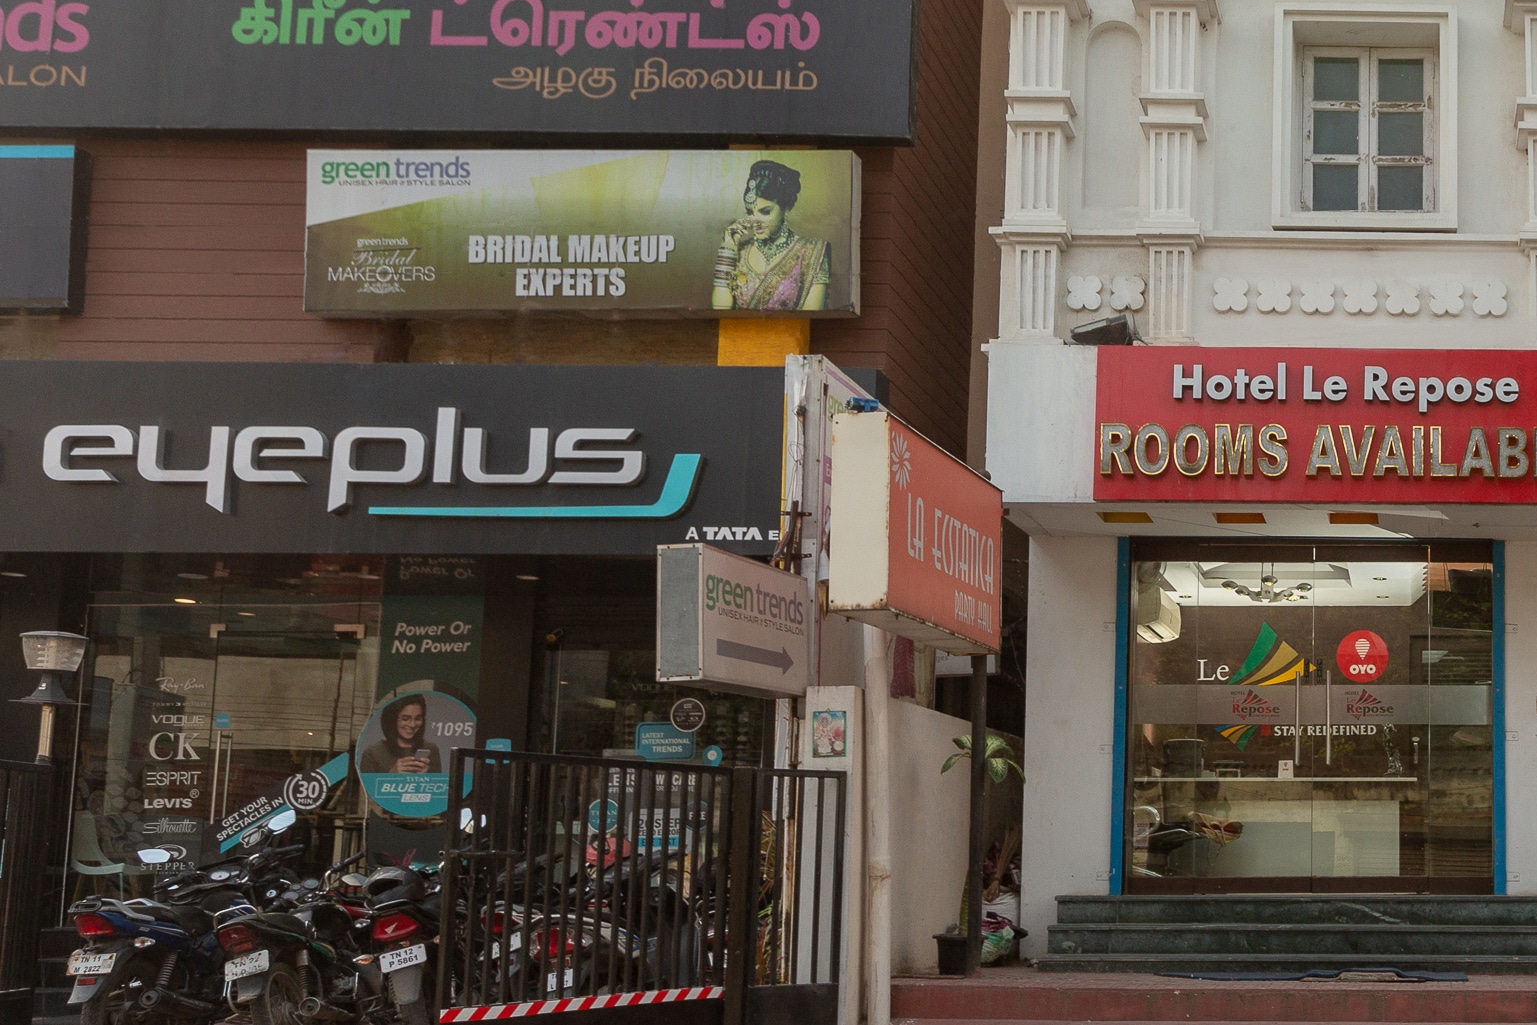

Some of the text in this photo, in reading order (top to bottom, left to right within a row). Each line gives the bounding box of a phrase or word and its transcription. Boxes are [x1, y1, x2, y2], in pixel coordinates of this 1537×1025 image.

[492, 57, 818, 100] அழகு நிலையம்
[321, 155, 471, 185] green trends
[356, 236, 382, 248] green
[468, 234, 675, 264] BRIDAL MAKEUP
[351, 248, 418, 266] Bridal
[328, 265, 436, 282] MAKEOVERS
[515, 268, 627, 297] EXPERTS
[1172, 363, 1520, 412] Hotel Le Repose
[1100, 422, 1288, 477] ROOMS
[42, 407, 645, 514] eyeplus
[685, 526, 699, 540] A
[703, 527, 763, 540] TATA
[908, 492, 924, 561] LA
[706, 574, 803, 625] green trends
[954, 589, 993, 634] PARTY HALL
[394, 620, 472, 637] Power Or
[718, 606, 742, 621] UNISEX
[743, 611, 759, 625] HAIR
[764, 619, 783, 632] STYLE
[783, 623, 804, 636] SALON
[391, 639, 471, 654] No Power
[1197, 659, 1229, 681] Le
[1350, 664, 1376, 674] OYO
[156, 677, 205, 693] Ray-Ban
[1232, 704, 1280, 717] Repose
[1347, 704, 1394, 717] Repose
[152, 715, 205, 726] VOGUE
[1274, 725, 1376, 736] STAY REDEFINED
[149, 732, 200, 760] CK
[147, 772, 201, 785] ESPRIT
[296, 781, 320, 799] 30
[381, 783, 416, 793] BLUE
[402, 794, 430, 802] LENS
[216, 796, 284, 841] SPECTACLES IN
[222, 796, 268, 827] GET YOUR
[143, 817, 197, 834] Silhouette
[141, 862, 195, 871] STEPPER
[389, 954, 419, 968] P 5861
[390, 948, 414, 960] TN 12
